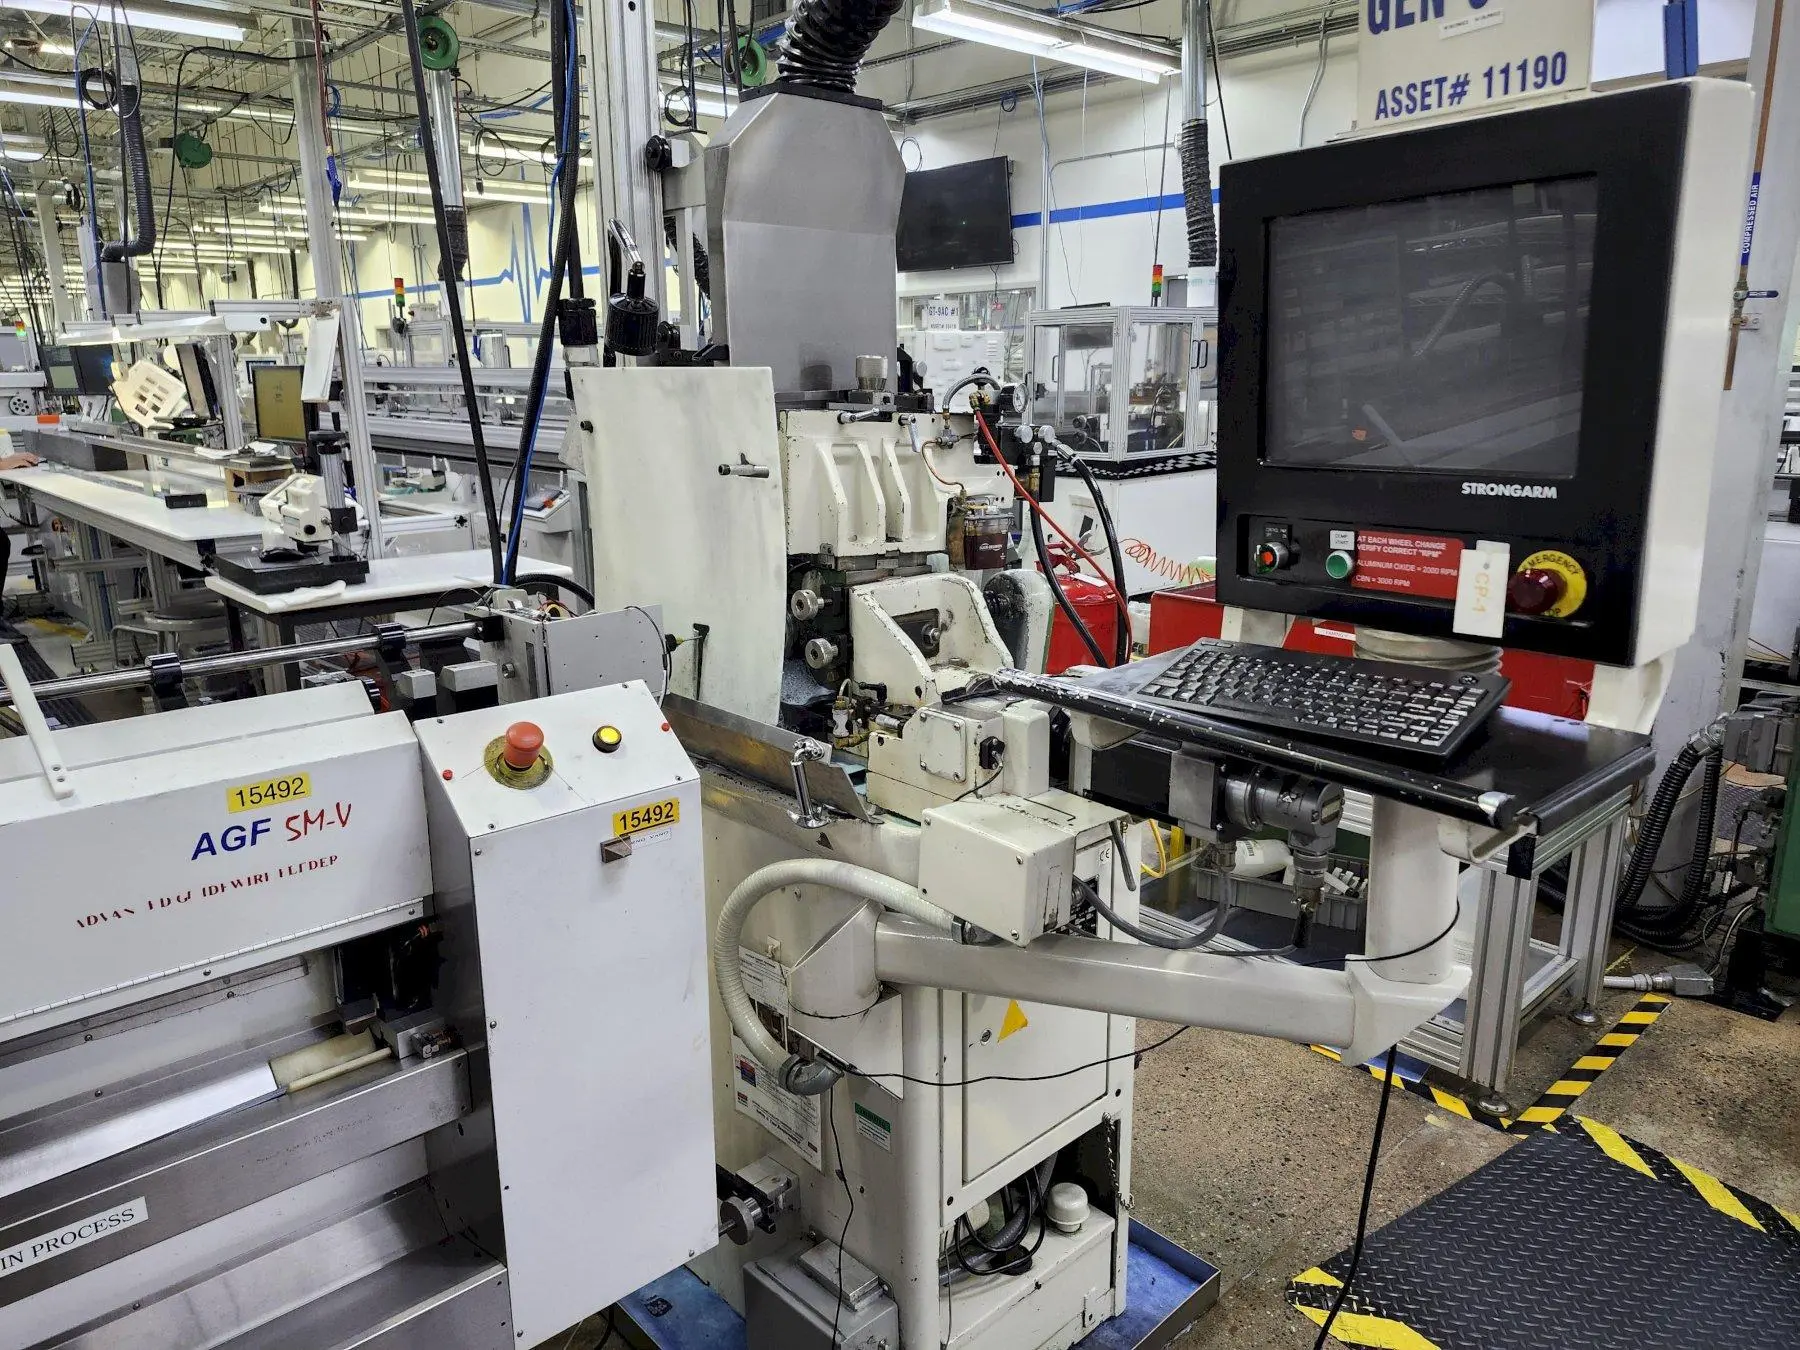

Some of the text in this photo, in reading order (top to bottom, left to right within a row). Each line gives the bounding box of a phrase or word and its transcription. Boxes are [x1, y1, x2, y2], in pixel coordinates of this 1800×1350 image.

[1375, 51, 1568, 121] ASSET# 11190
[1742, 184, 1759, 254] COMPRESSED AIR
[1461, 482, 1558, 499] STRONGARM
[1357, 535, 1366, 543] AT
[1367, 536, 1388, 545] EACH
[1388, 538, 1414, 547] WHEEL
[1414, 540, 1447, 550] CHANGE
[1357, 544, 1382, 553] VERIFY
[1382, 546, 1418, 556] CORRECT
[1357, 559, 1393, 569] ALUMINUM
[1393, 563, 1416, 572] OXIDE
[1440, 568, 1458, 577] RPM
[1522, 553, 1580, 575] MERGENCY
[1393, 579, 1411, 587] RPM
[236, 777, 305, 807] 15492
[619, 802, 674, 831] 15492
[191, 818, 271, 860] AGF
[1, 1208, 135, 1271] IN PROCESS
